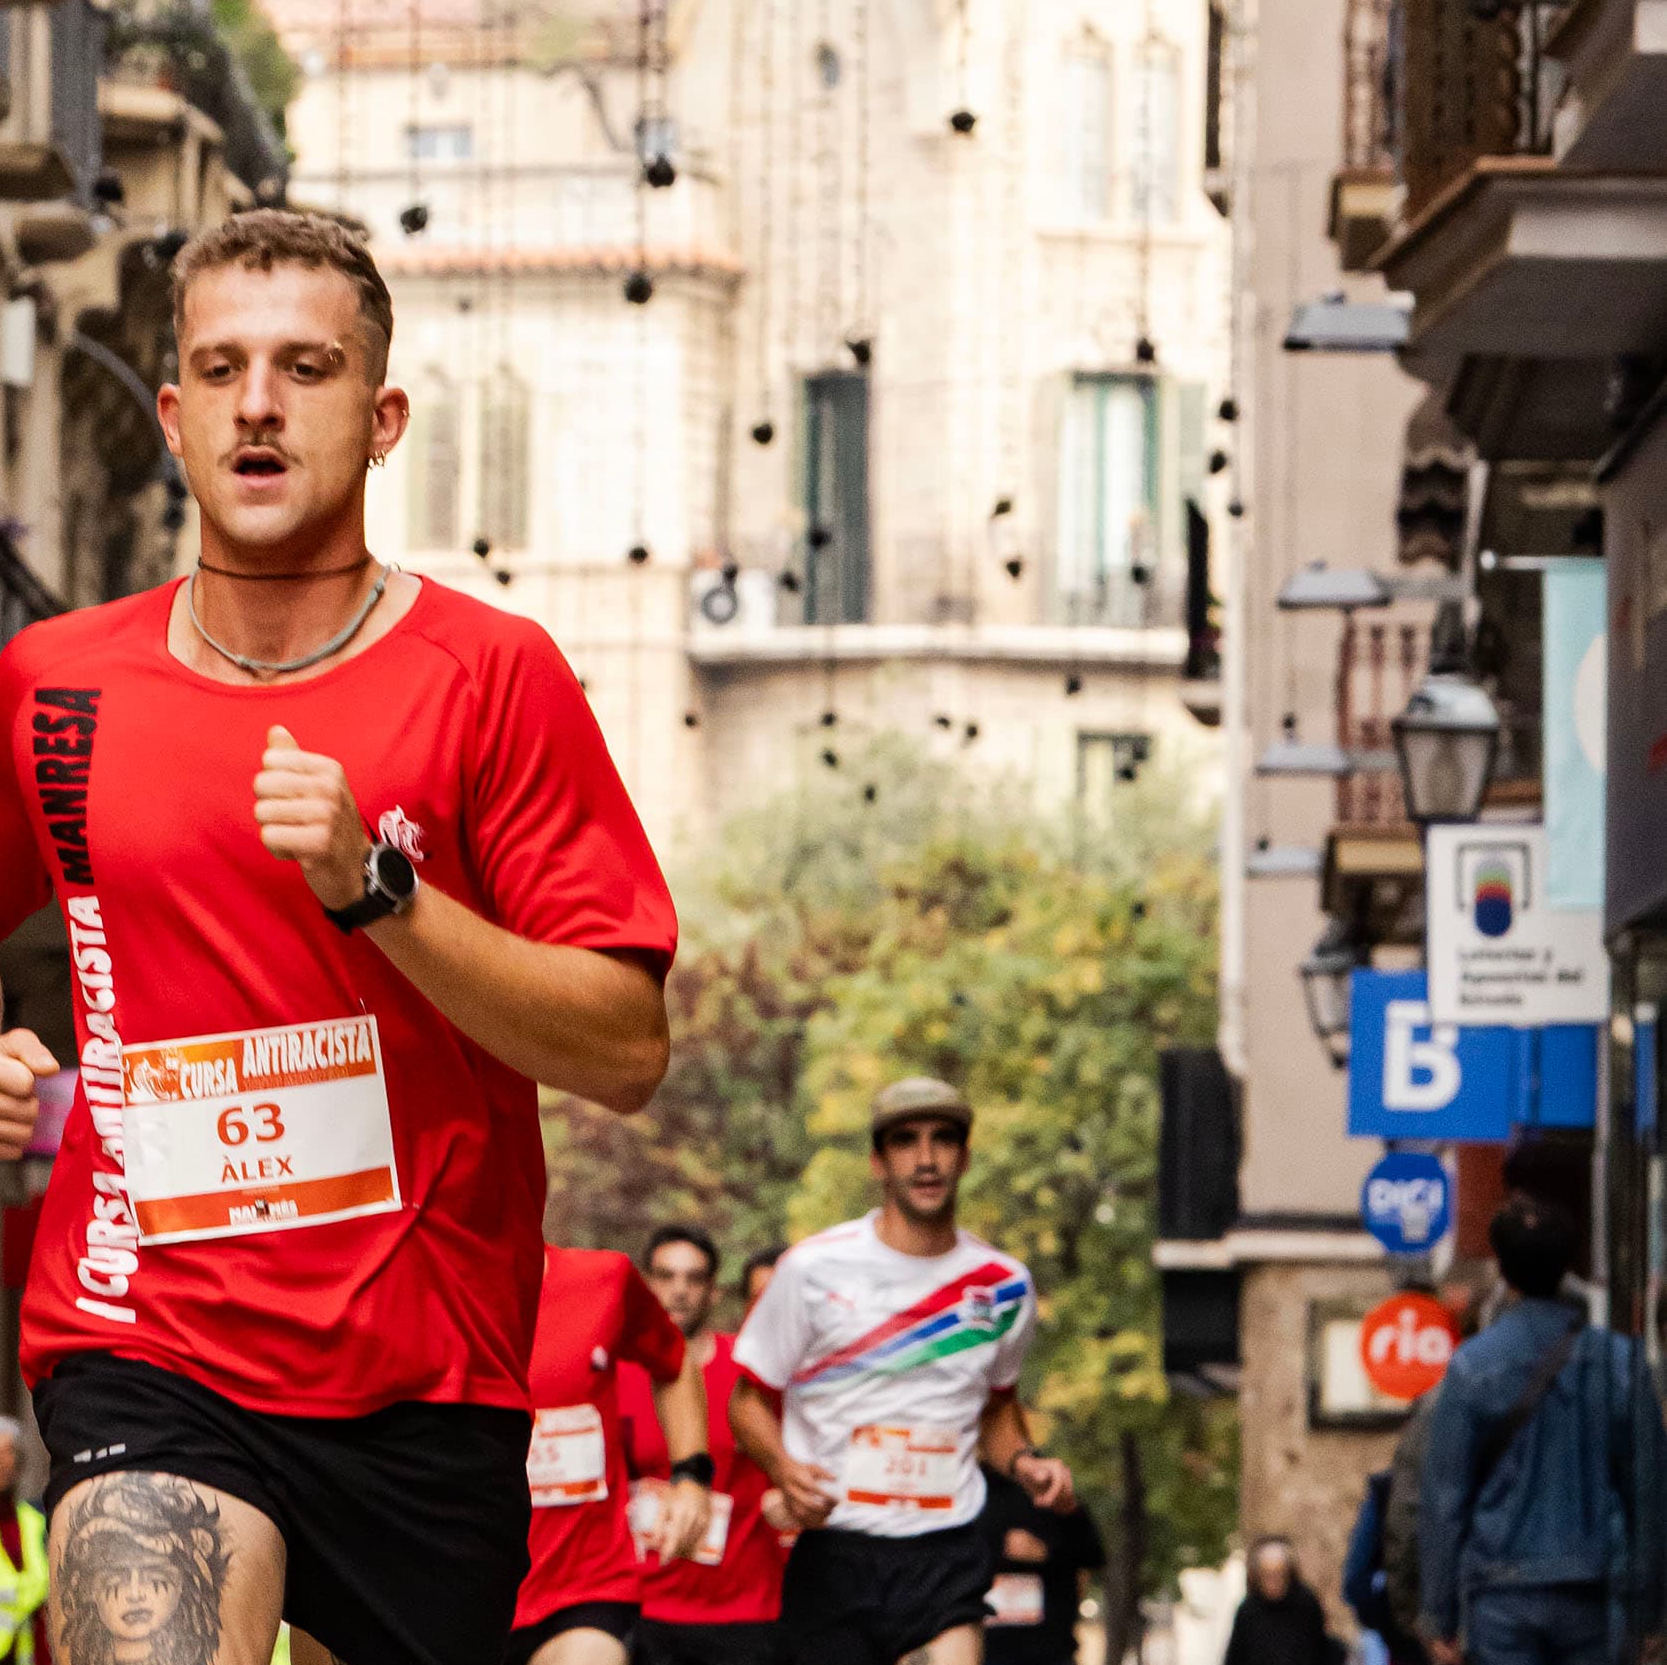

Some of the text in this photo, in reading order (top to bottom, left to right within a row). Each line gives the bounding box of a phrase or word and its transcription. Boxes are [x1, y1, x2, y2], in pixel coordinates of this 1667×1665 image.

[32, 687, 102, 886] MANRESA
[179, 1057, 239, 1100] CURSA
[242, 1022, 373, 1079] ANTIRACISTA
[1382, 999, 1462, 1112] B
[216, 1102, 286, 1147] 63
[220, 1154, 295, 1184] ÀLEX
[77, 1171, 139, 1297] CURSA
[1369, 1308, 1453, 1365] ria
